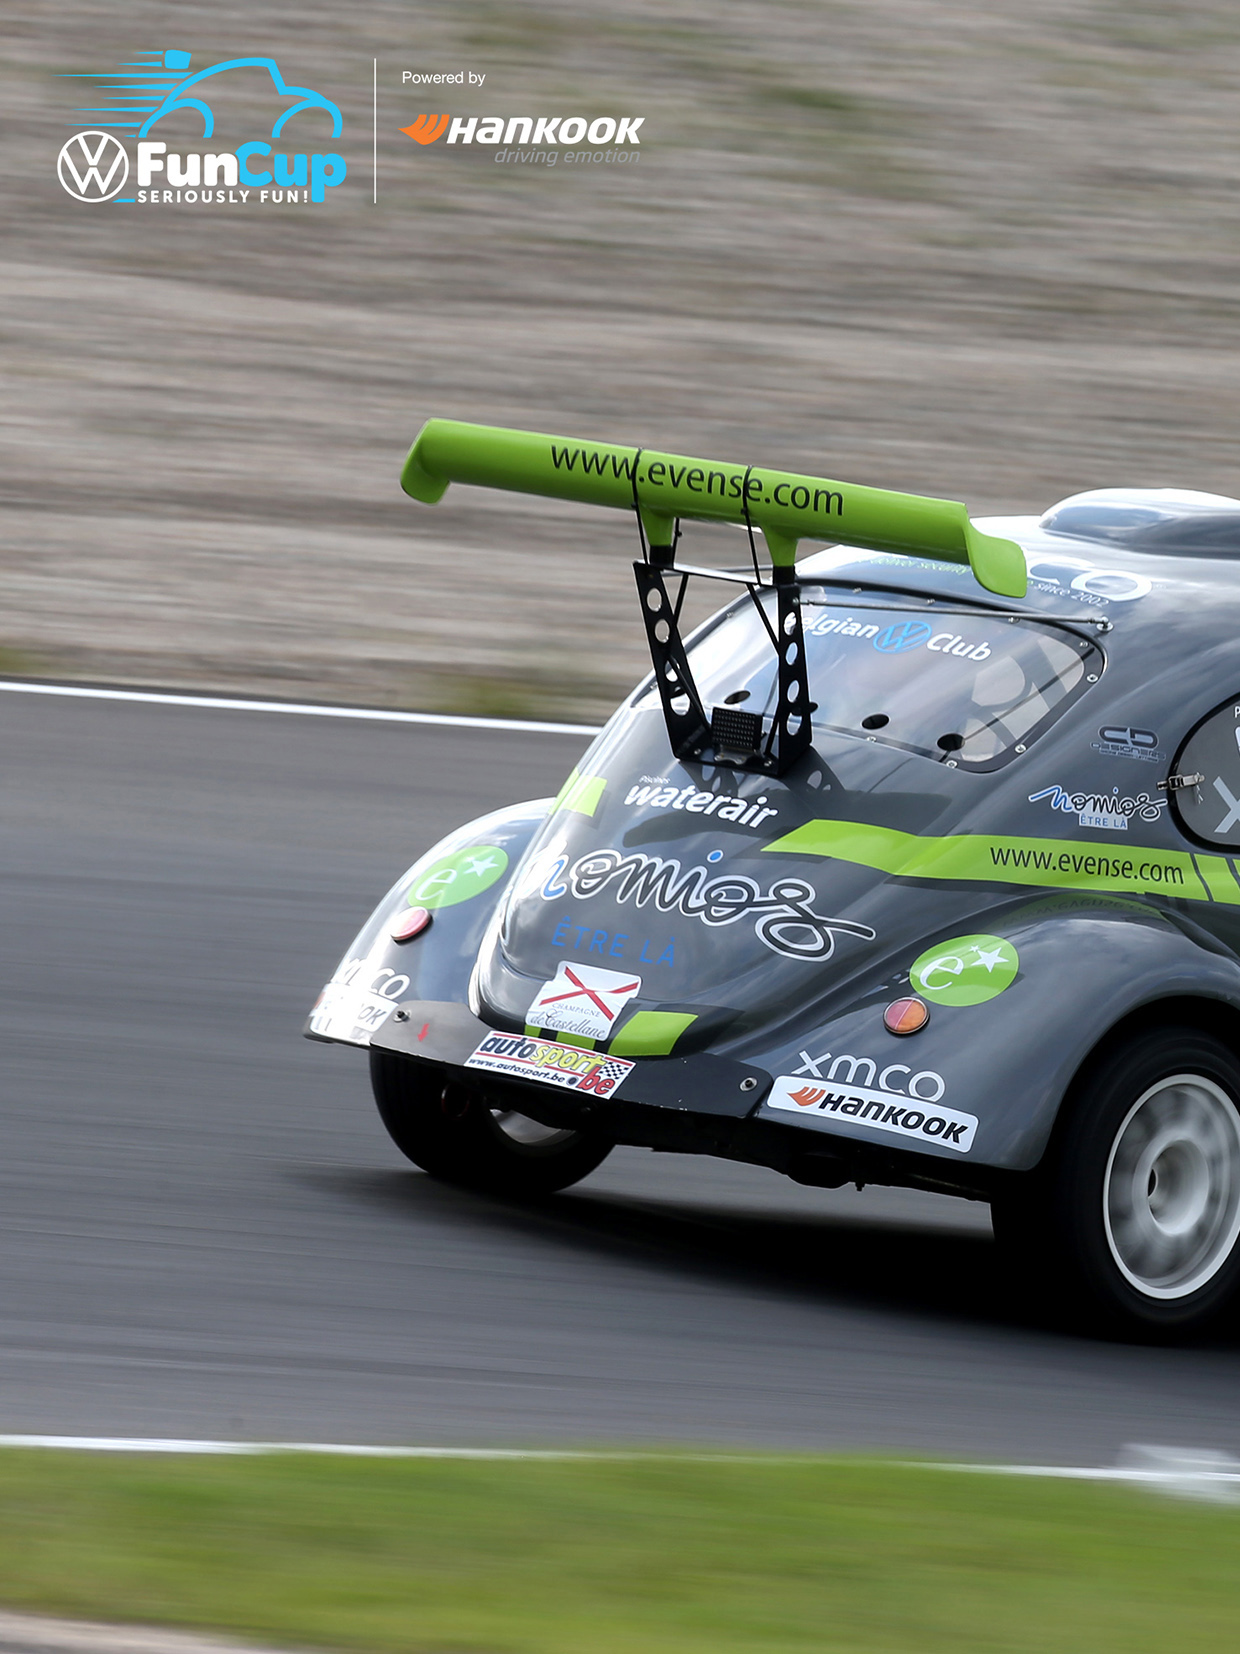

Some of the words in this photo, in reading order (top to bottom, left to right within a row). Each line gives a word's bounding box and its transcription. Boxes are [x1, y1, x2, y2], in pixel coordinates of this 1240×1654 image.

[551, 444, 844, 517] www.evense.com
[926, 633, 992, 661] Club
[623, 785, 779, 829] waterair
[1028, 784, 1168, 822] nomios
[1080, 813, 1109, 827] ÊTRE
[990, 847, 1184, 885] www.evense.com
[551, 915, 629, 958] ÊTRE
[639, 936, 675, 968] LÀ
[545, 1008, 607, 1039] Castellane
[551, 1002, 601, 1018] CHAMPAGNE
[468, 1057, 566, 1083] www.autosport.be
[790, 1050, 946, 1103] xmco
[818, 1092, 969, 1144] HANKOOK
